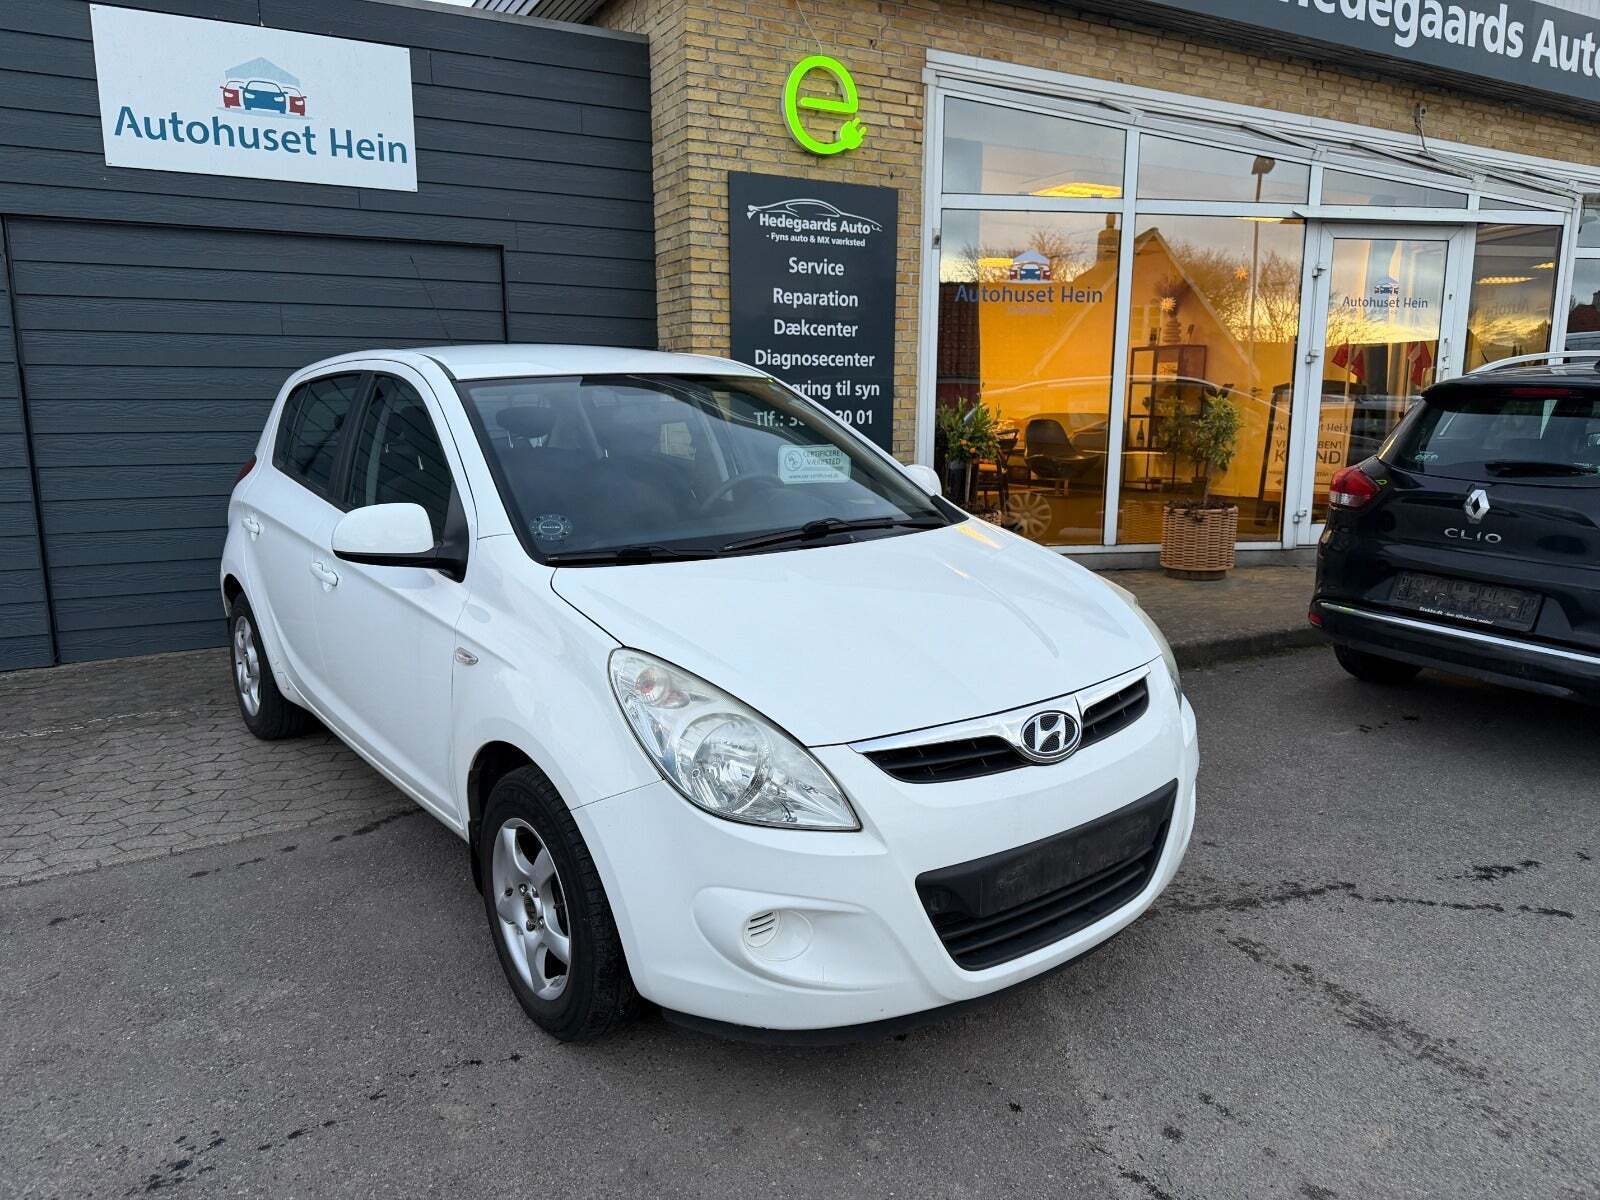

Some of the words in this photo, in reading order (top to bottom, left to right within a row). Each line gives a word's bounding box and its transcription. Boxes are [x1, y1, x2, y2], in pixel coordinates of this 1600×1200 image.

[1279, 0, 1525, 58] egaards
[114, 105, 317, 156] Autohuset
[329, 127, 408, 164] Hein
[759, 213, 837, 232] Hedegaards
[839, 220, 871, 235] Auto
[770, 232, 789, 242] Fyns
[790, 234, 809, 243] auto
[809, 235, 816, 243] &
[816, 235, 830, 244] MX
[788, 256, 845, 276] Service
[773, 287, 859, 309] Reparation
[955, 284, 1055, 303] Autohuset
[1061, 286, 1104, 303] Hein
[1343, 295, 1400, 308] Autohuset
[1403, 297, 1429, 309] Hein
[774, 318, 859, 337] Dækcenter
[755, 348, 876, 370] Diagnosecenter
[835, 380, 851, 396] til
[855, 383, 880, 400] syn
[856, 409, 873, 425] 01
[1318, 450, 1341, 464] ND
[1443, 527, 1502, 544] CLIO
